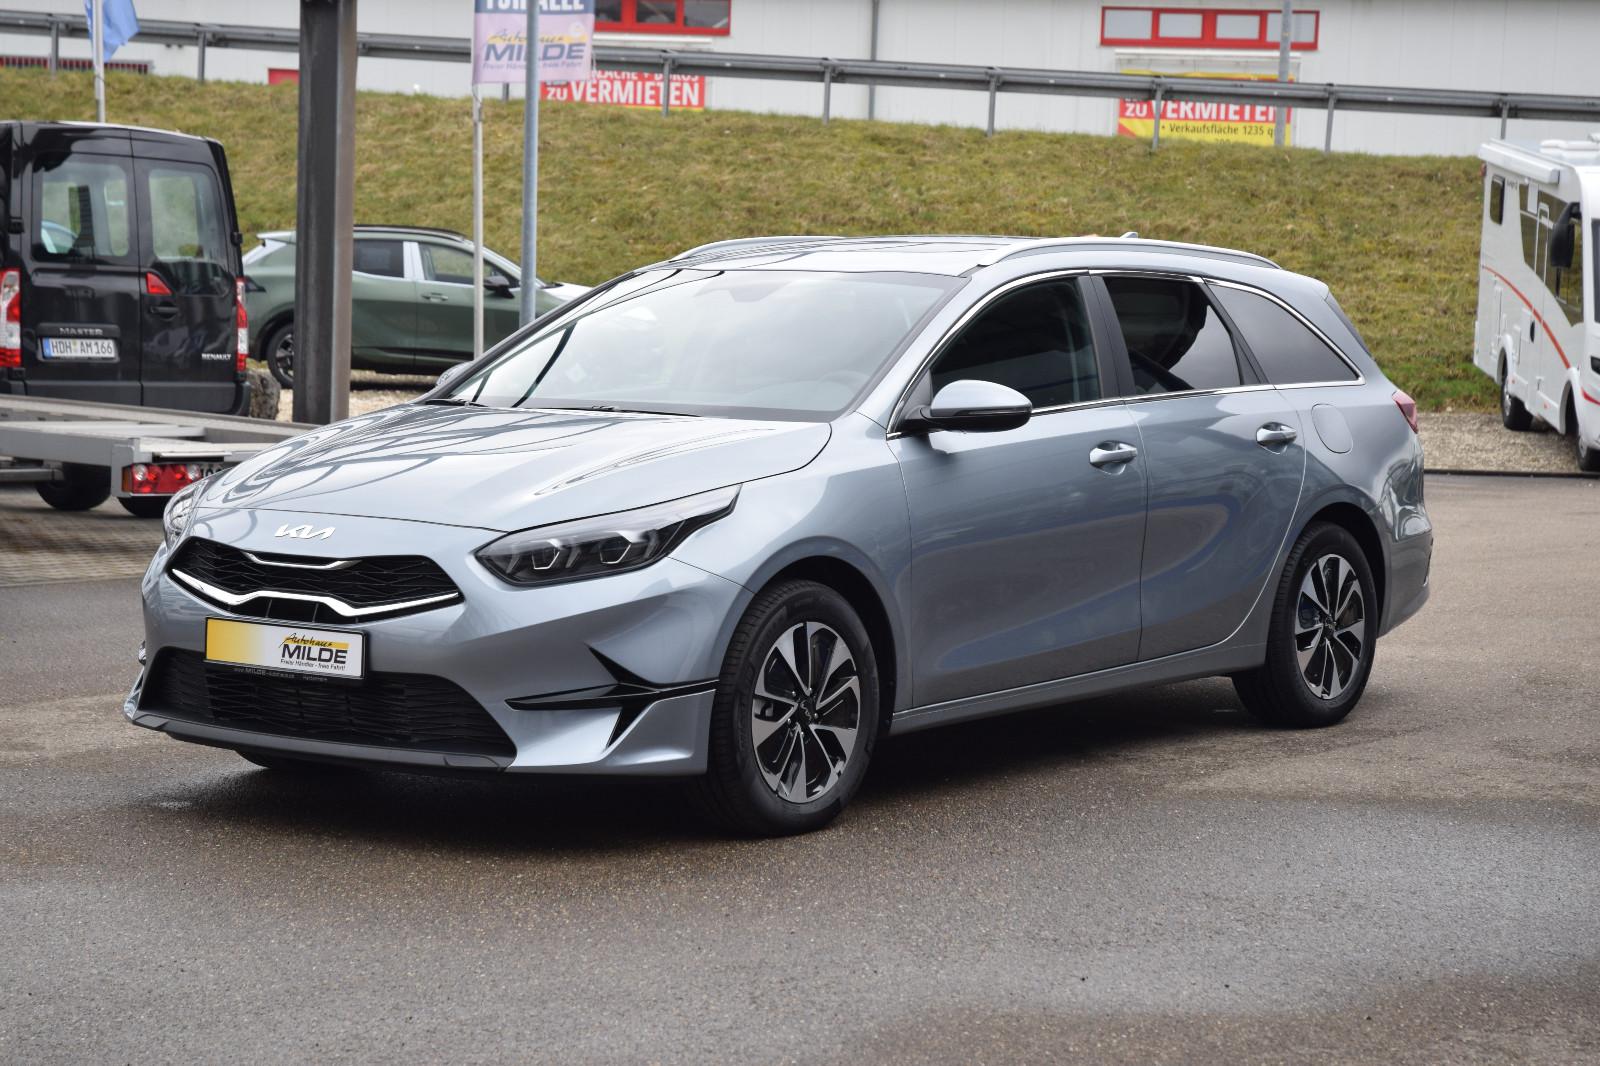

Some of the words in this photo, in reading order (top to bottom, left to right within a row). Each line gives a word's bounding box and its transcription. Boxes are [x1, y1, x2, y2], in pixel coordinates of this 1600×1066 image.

[484, 43, 587, 62] MIDE
[1243, 126, 1264, 136] 1235
[59, 326, 103, 336] MASTER
[51, 342, 72, 355] HDH
[80, 342, 94, 355] AM
[96, 342, 113, 355] 166
[201, 353, 232, 361] RENAULT
[278, 632, 333, 649] Autohaus
[281, 643, 348, 665] MILDE
